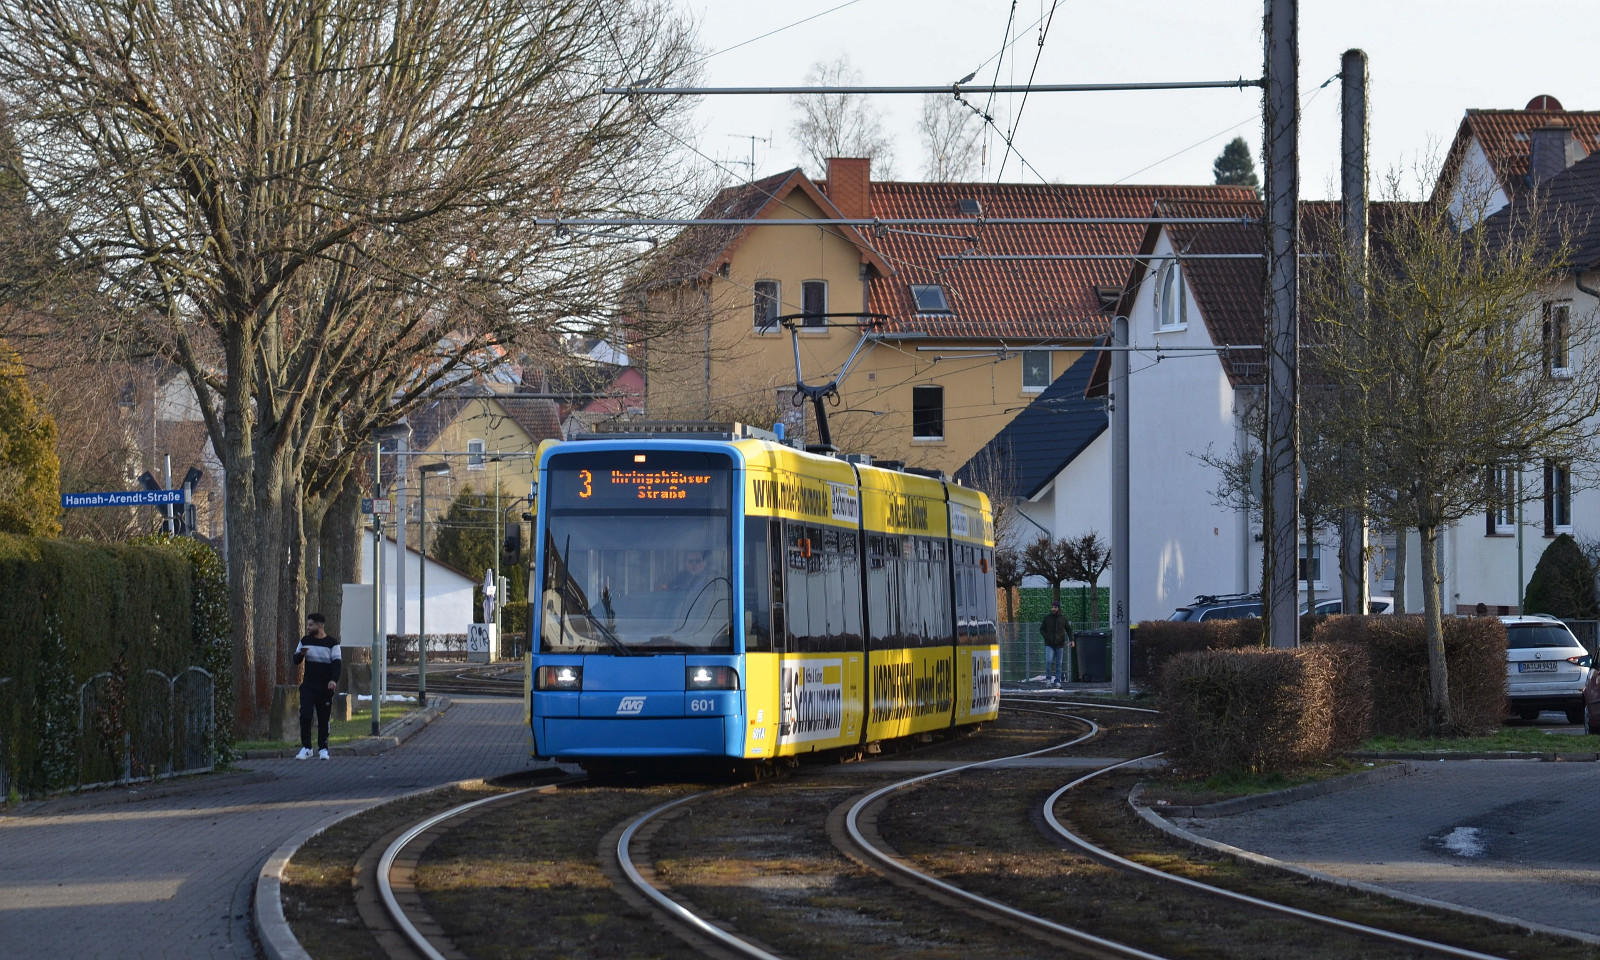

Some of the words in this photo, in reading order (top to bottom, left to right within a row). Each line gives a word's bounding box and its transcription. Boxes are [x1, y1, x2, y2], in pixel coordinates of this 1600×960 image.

[579, 469, 592, 498] 3
[65, 491, 181, 506] Hannah-Arendt-Straße
[617, 698, 645, 712] KVG
[691, 699, 715, 711] 601
[793, 667, 840, 735] Schaumann
